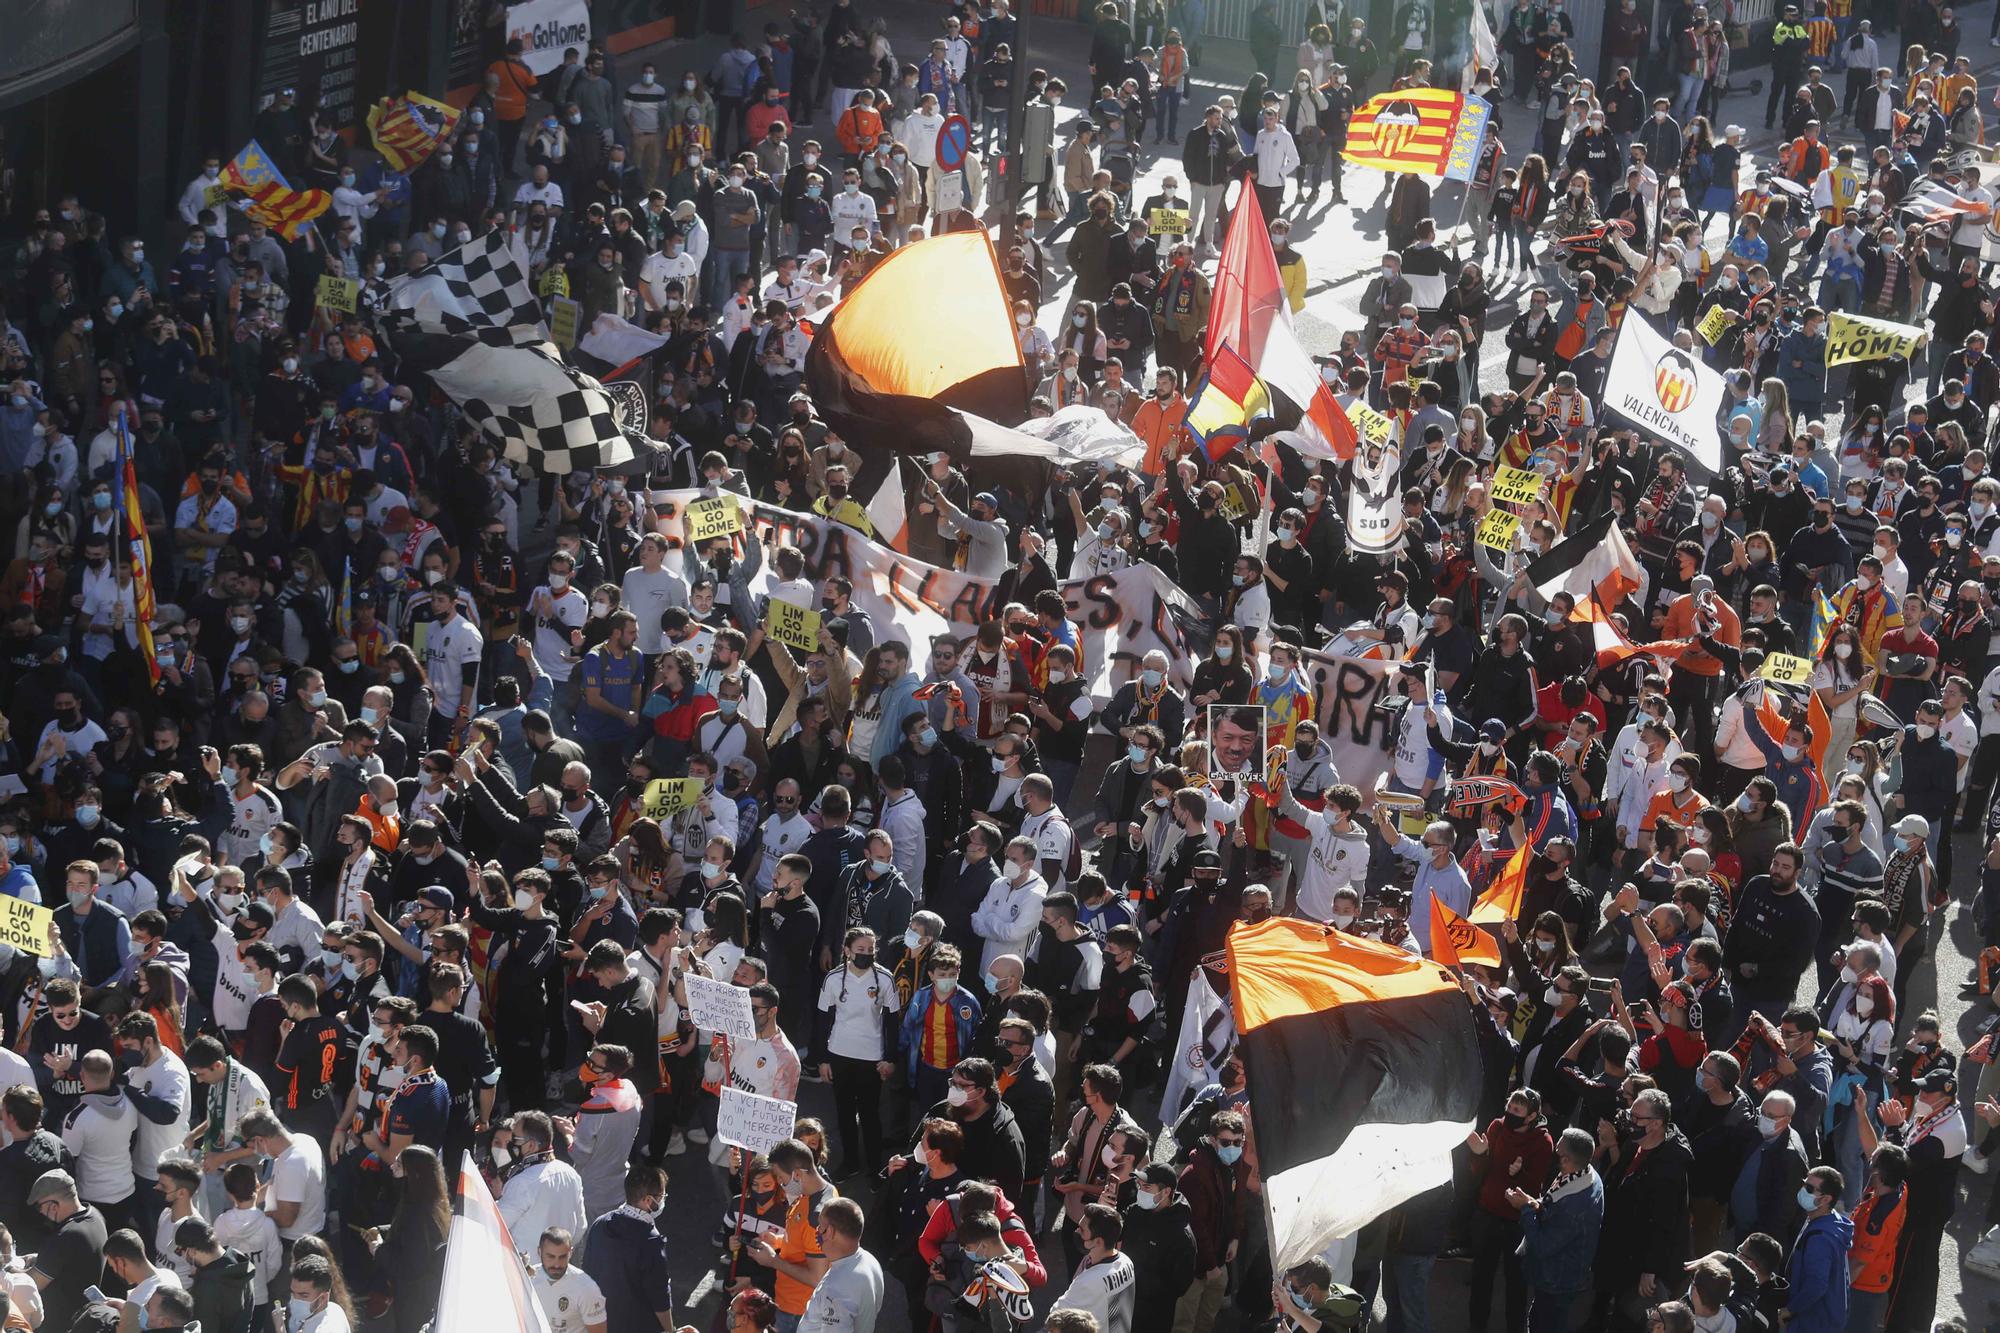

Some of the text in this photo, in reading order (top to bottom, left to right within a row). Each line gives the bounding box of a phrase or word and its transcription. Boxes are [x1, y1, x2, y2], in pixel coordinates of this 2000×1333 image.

[306, 3, 318, 25] EL
[341, 0, 358, 16] DEL
[300, 22, 357, 57] CENTENARIO
[1841, 176, 1856, 199] 10
[1160, 210, 1178, 219] LIM
[1154, 225, 1184, 233] HOME
[1828, 335, 1911, 363] HOME
[1622, 394, 1699, 448] VALENCIA CF
[1505, 470, 1536, 483] LIM
[1508, 480, 1524, 489] GO
[1491, 485, 1535, 503] HOME
[699, 500, 724, 512] LIM
[705, 510, 724, 522] GO
[1360, 518, 1390, 530] SUD
[1490, 510, 1514, 527] LIM
[697, 519, 735, 537] HOME
[1492, 524, 1504, 534] GO
[1477, 530, 1512, 550] HOME
[782, 604, 804, 622] LIM
[783, 618, 802, 632] GO
[773, 625, 811, 648] HOME
[1773, 655, 1797, 670] LIM
[1772, 668, 1793, 680] GO
[1208, 771, 1265, 782] GAME OVER
[658, 782, 685, 794] LIM
[660, 795, 682, 806] GO
[9, 901, 35, 921] LIM
[10, 917, 31, 933] GO
[0, 926, 42, 951] HOME
[691, 990, 706, 1000] CON
[691, 1008, 754, 1039] GAME OVER
[722, 1089, 733, 1102] EL
[740, 1092, 760, 1109] VCF
[734, 1104, 793, 1126] UN FUTURO
[722, 1112, 793, 1137] YO MEREZCO
[745, 1134, 761, 1148] ESE
